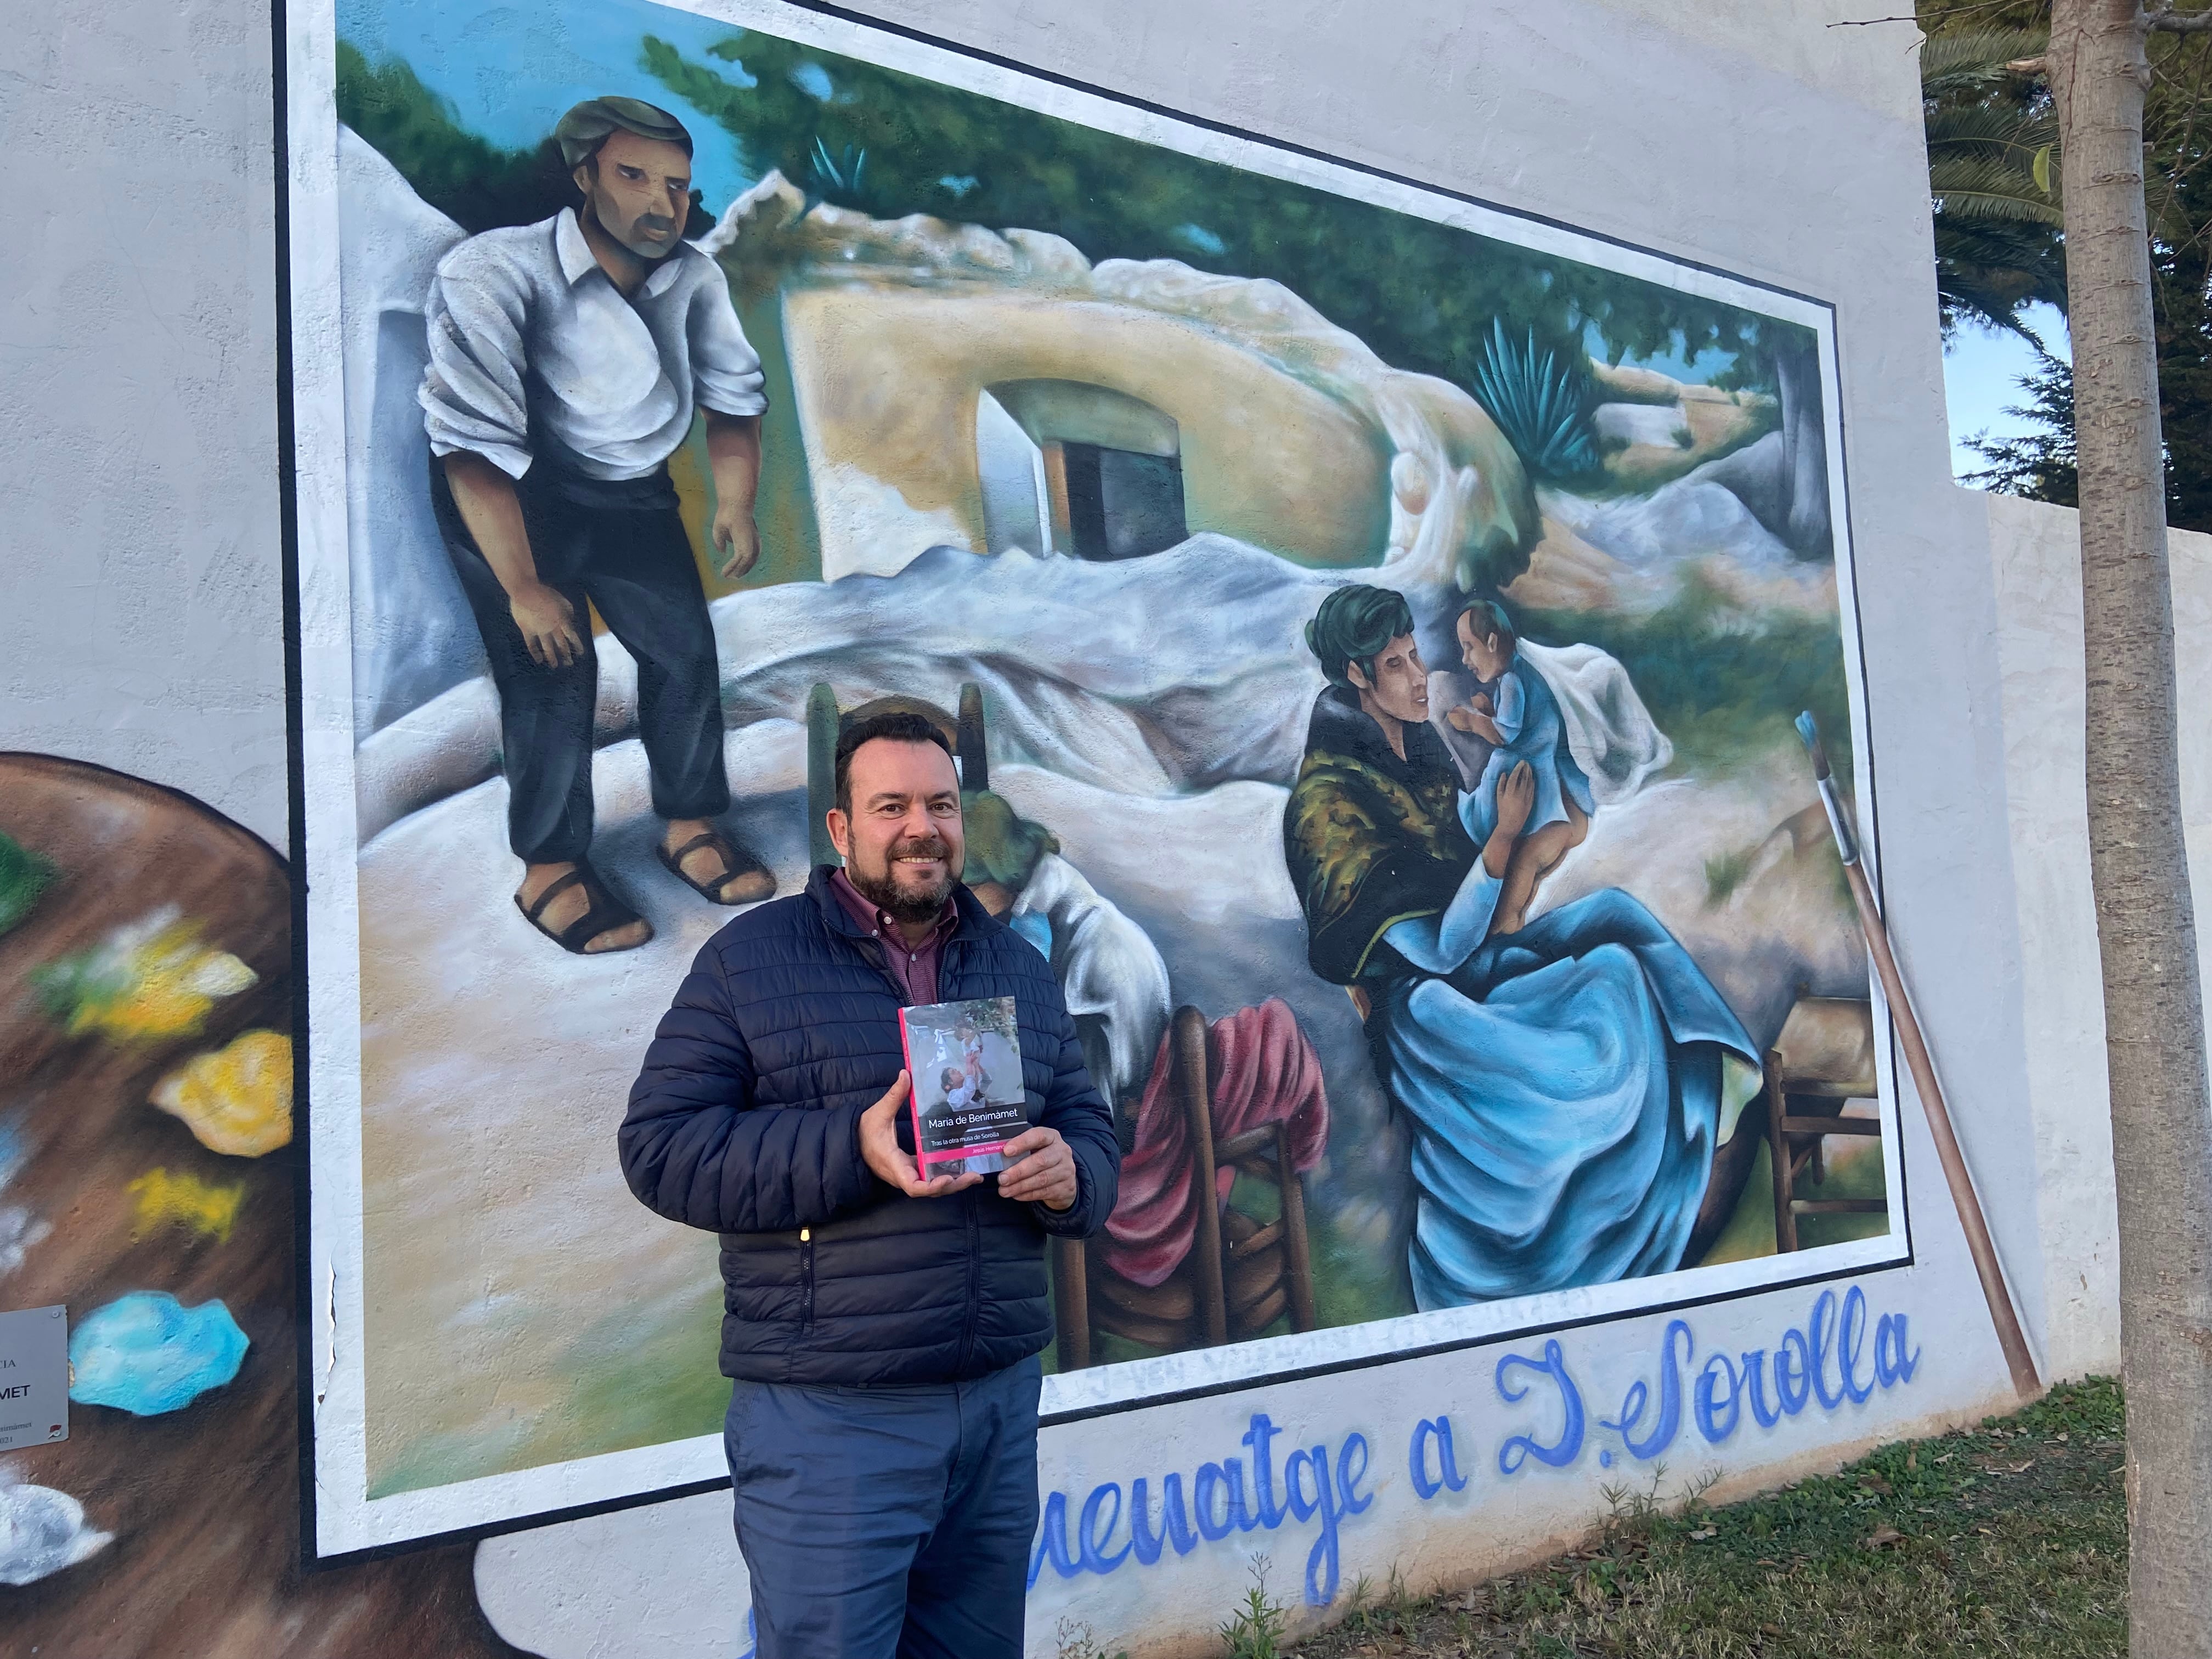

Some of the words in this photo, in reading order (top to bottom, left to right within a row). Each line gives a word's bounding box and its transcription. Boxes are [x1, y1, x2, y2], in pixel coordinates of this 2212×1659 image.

[929, 1117, 953, 1128] María
[955, 1115, 967, 1125] de
[1409, 1415, 1468, 1500] a
[1599, 1285, 1920, 1460] Sorolla
